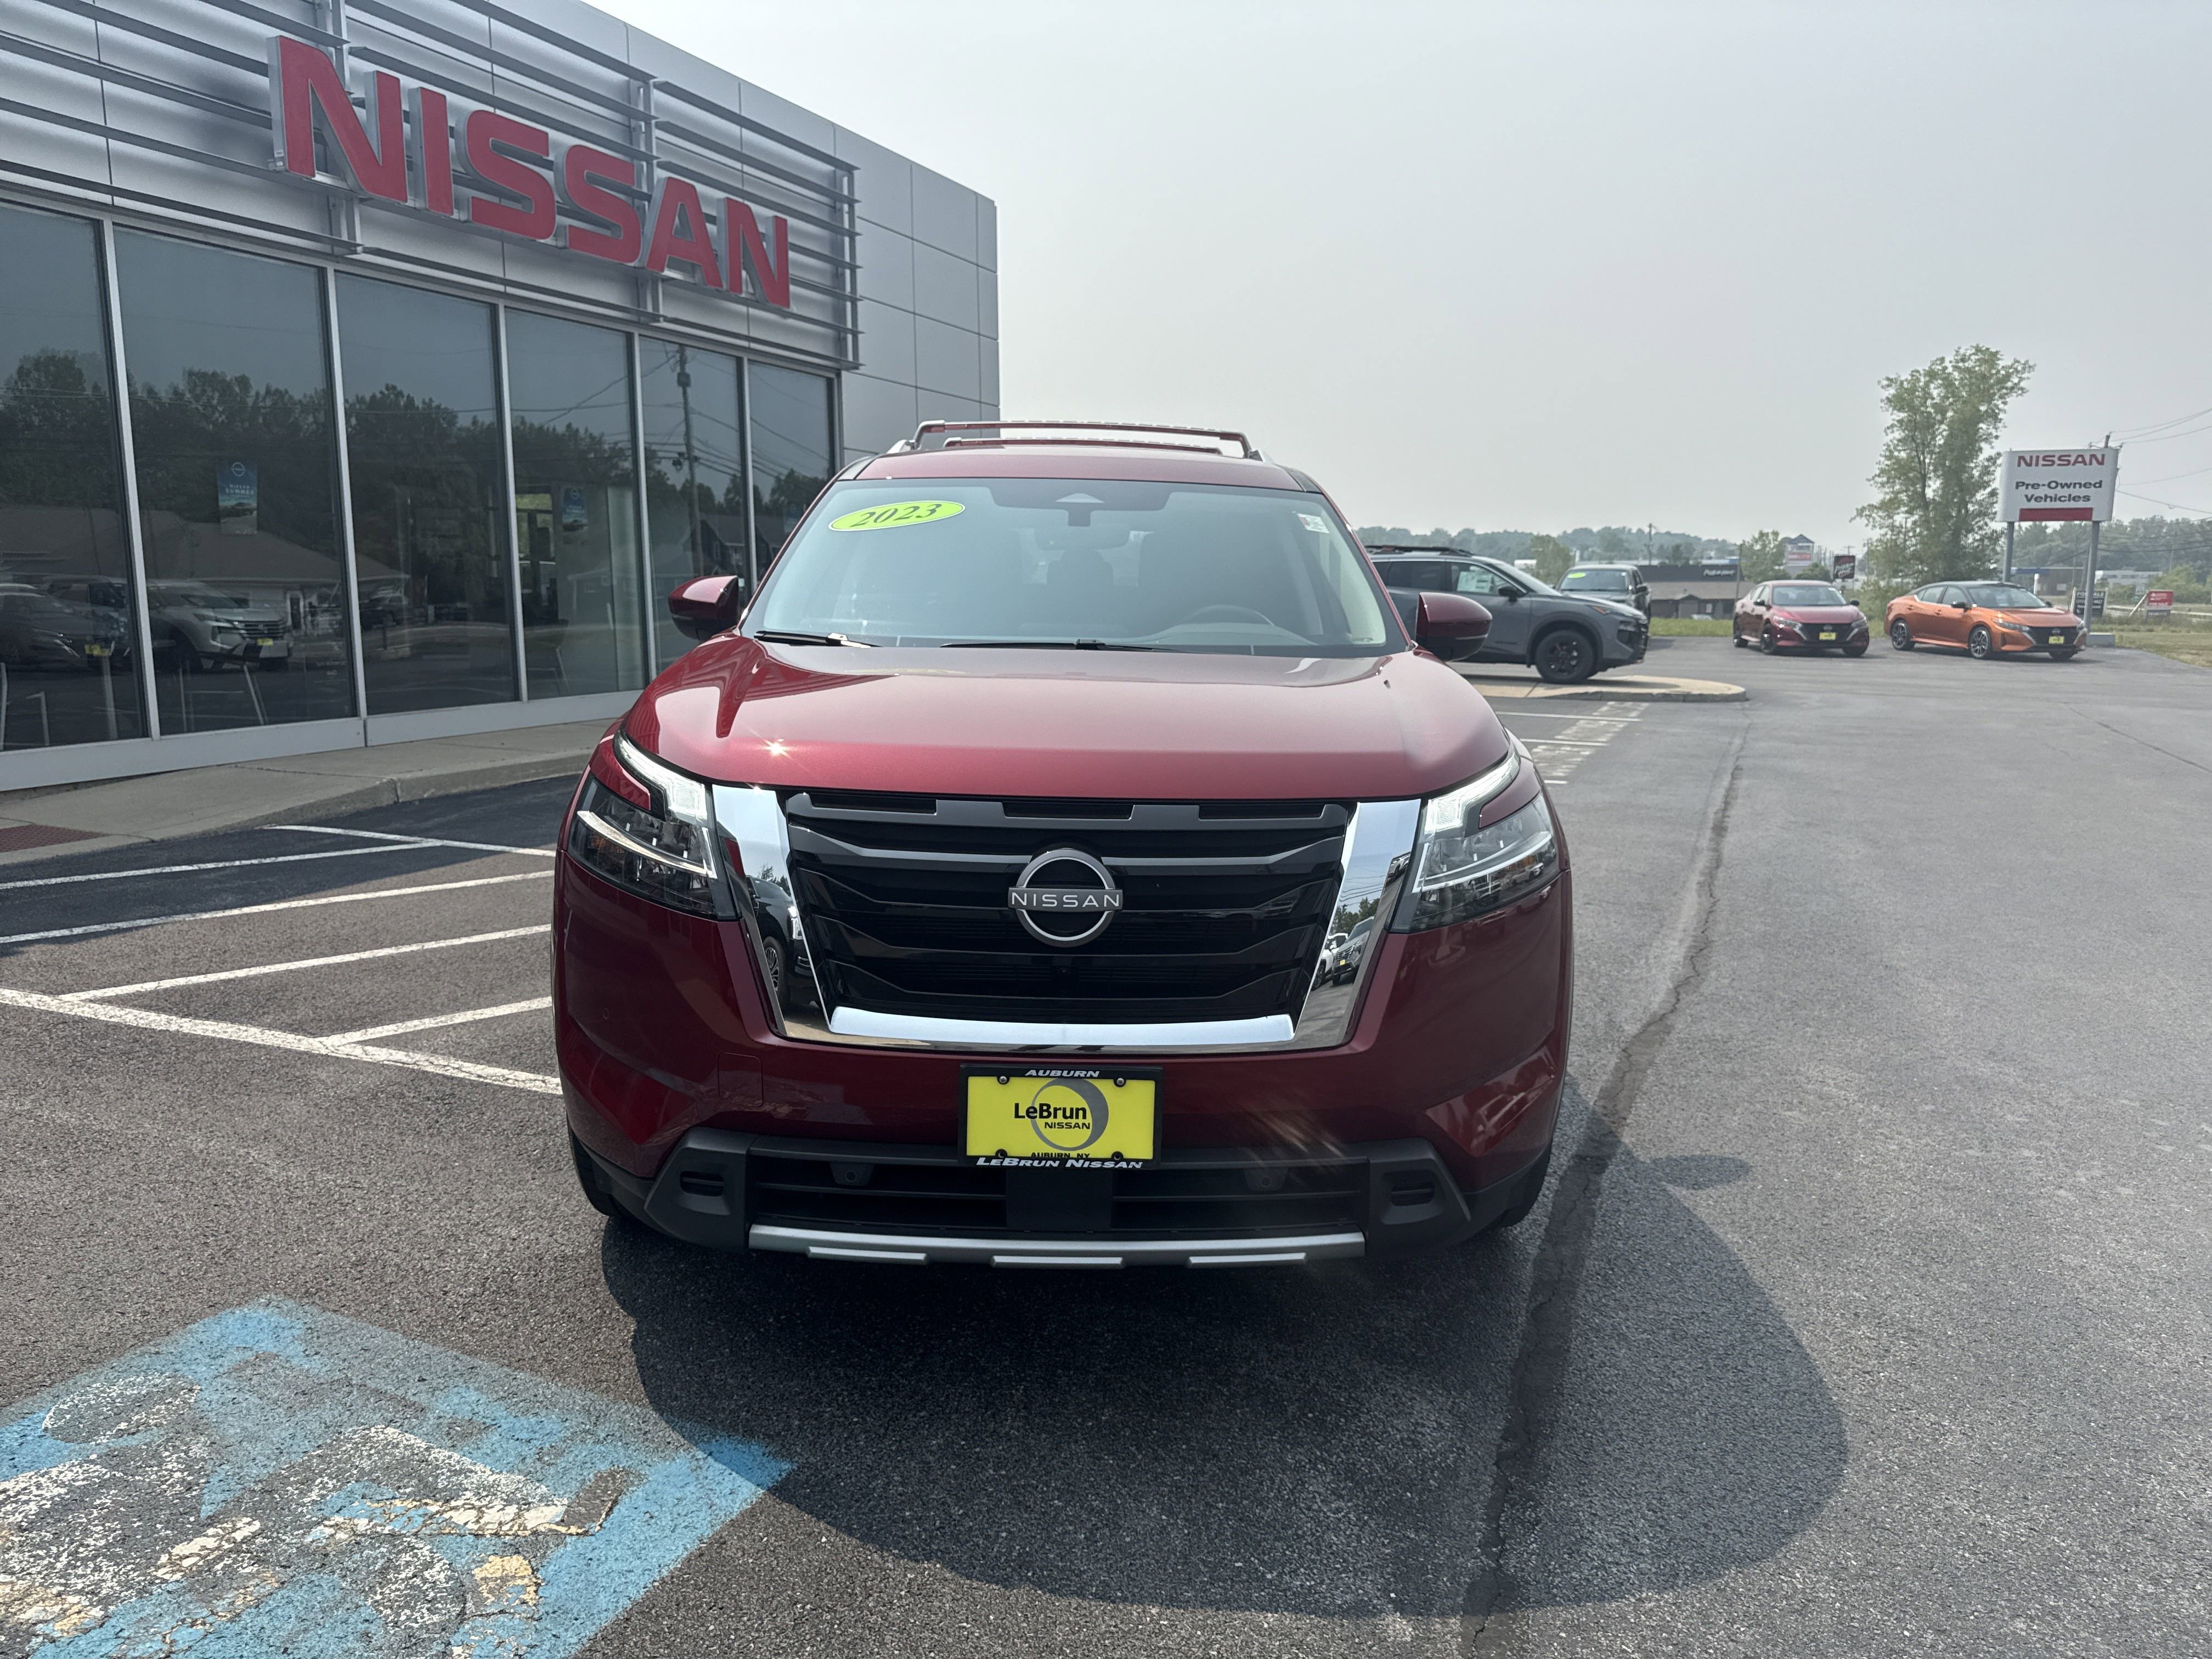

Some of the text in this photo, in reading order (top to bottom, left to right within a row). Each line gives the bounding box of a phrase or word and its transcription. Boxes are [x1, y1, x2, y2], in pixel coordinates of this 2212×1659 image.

[269, 35, 791, 309] NISSAN
[2017, 454, 2105, 467] NISSAN
[2015, 480, 2103, 490] Pre-Owned
[2024, 494, 2091, 503] Vehicles
[849, 504, 943, 528] 2023
[1011, 892, 1119, 907] NISSAN
[1025, 1069, 1101, 1077] AUBURN
[1014, 1103, 1087, 1120] LeBrun
[1044, 1121, 1091, 1130] NISSAN
